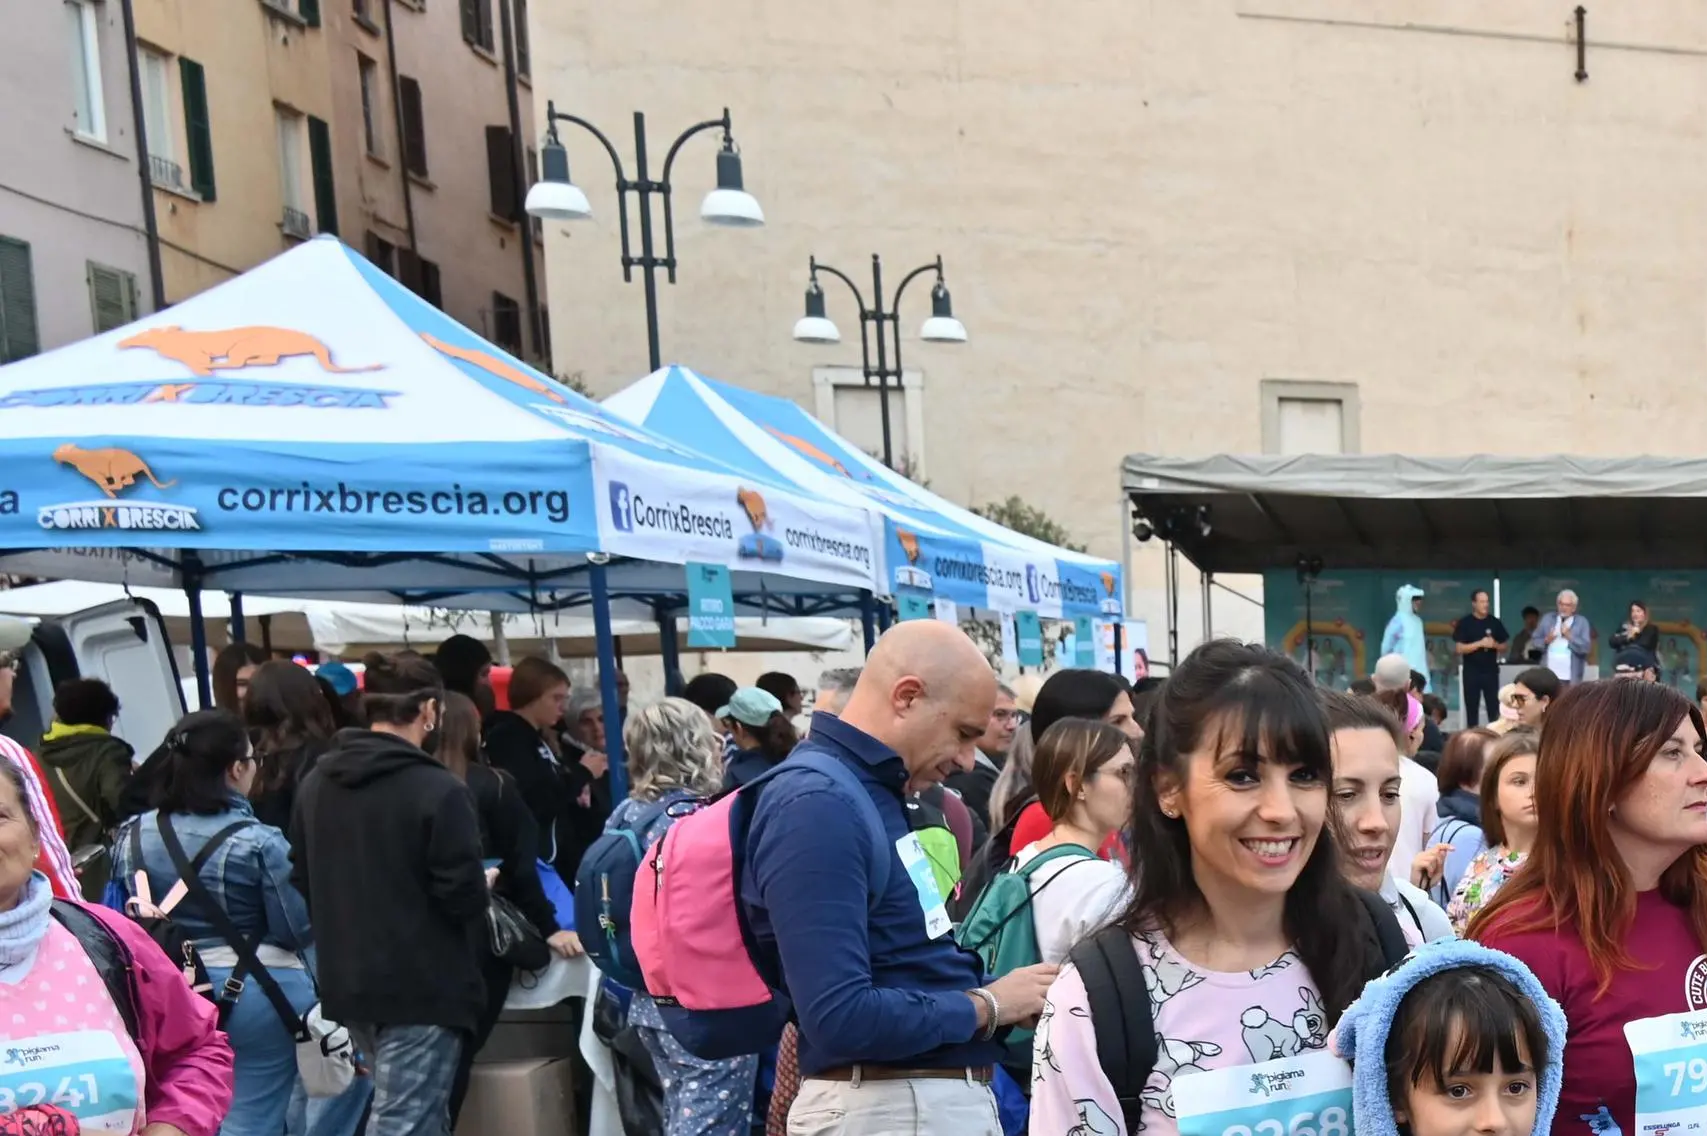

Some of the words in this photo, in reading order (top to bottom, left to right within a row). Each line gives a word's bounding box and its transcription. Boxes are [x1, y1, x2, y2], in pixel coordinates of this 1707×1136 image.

[218, 481, 570, 522] corrixbrescia.org
[633, 495, 733, 540] CorrixBrescia
[785, 526, 870, 569] corrixbrescia.org
[1691, 971, 1704, 1004] CUTE
[1267, 1069, 1305, 1084] pigiama
[1270, 1082, 1287, 1092] run
